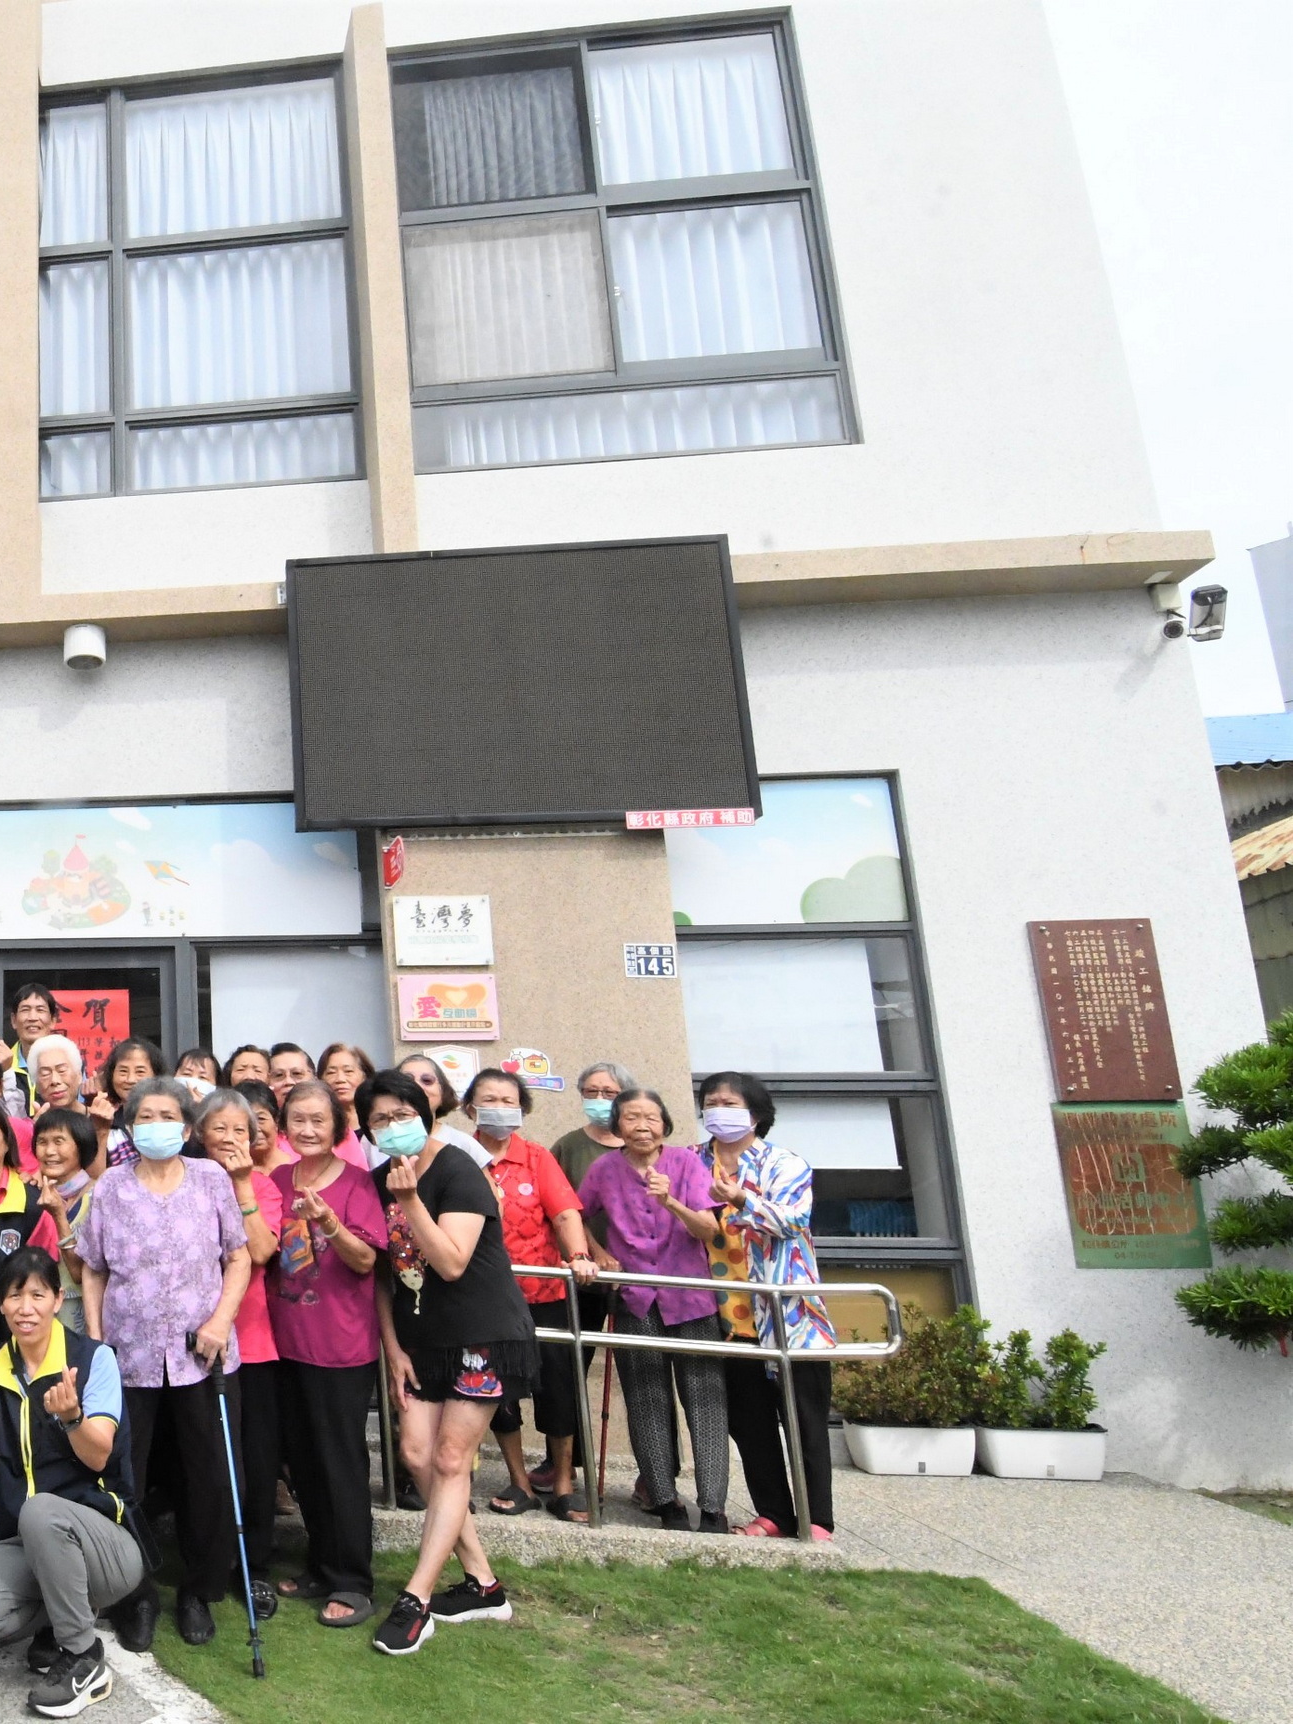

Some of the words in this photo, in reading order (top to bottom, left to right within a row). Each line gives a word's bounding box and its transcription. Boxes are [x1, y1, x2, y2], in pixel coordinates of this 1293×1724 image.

[628, 812, 714, 827] 彰化縣政府
[720, 810, 752, 824] 補助
[410, 900, 474, 928] 臺灣夢
[637, 957, 674, 975] 145
[83, 998, 111, 1033] 賀
